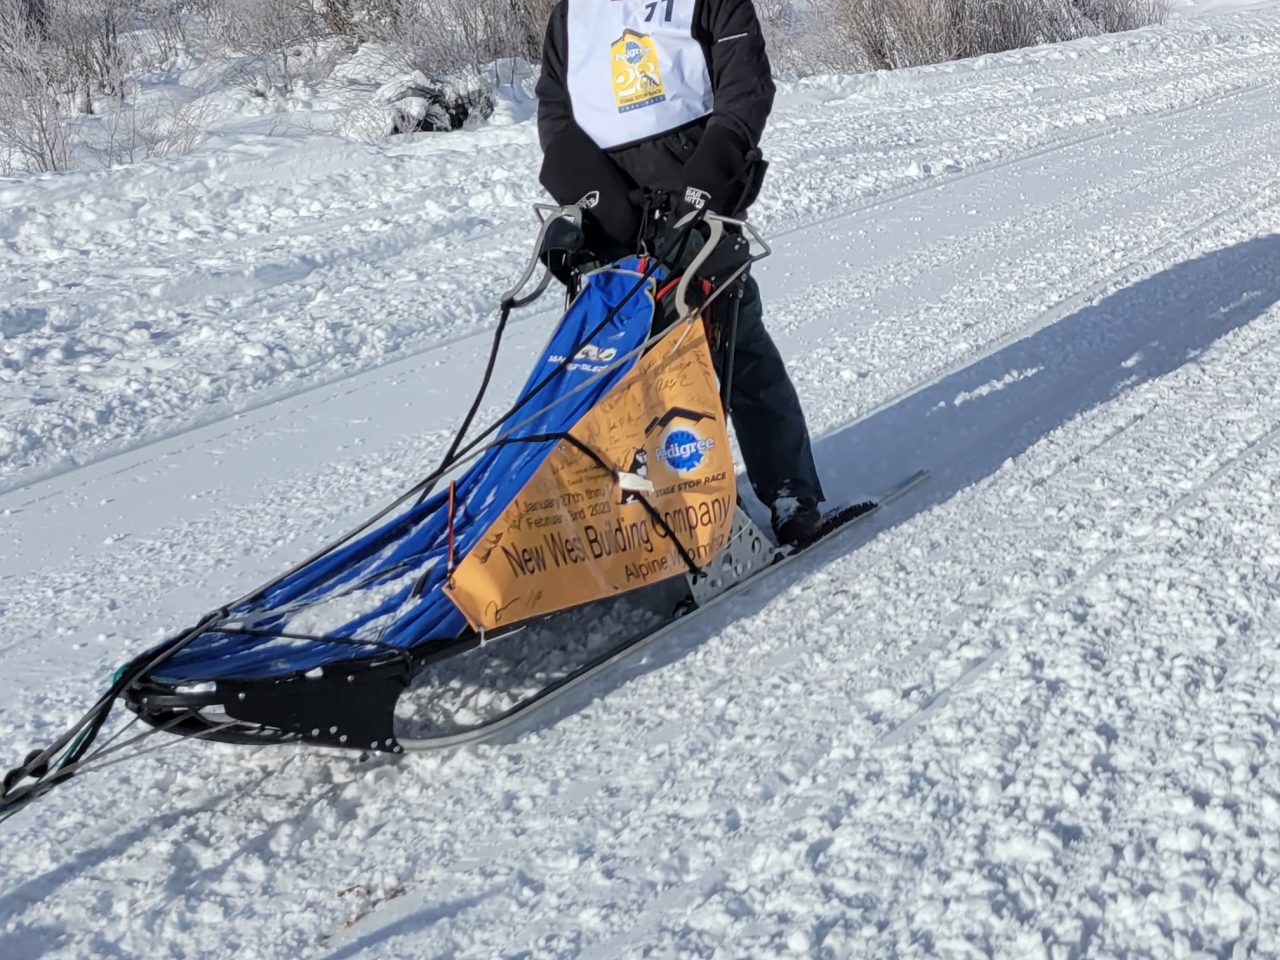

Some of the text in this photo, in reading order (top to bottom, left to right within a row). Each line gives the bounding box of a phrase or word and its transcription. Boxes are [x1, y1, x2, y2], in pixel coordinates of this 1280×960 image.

[655, 438, 714, 462] Pedigree
[677, 478, 702, 492] STOP
[703, 471, 727, 486] RACE
[560, 492, 584, 507] 27th
[500, 541, 547, 578] New
[543, 531, 590, 568] West
[584, 517, 654, 559] Building
